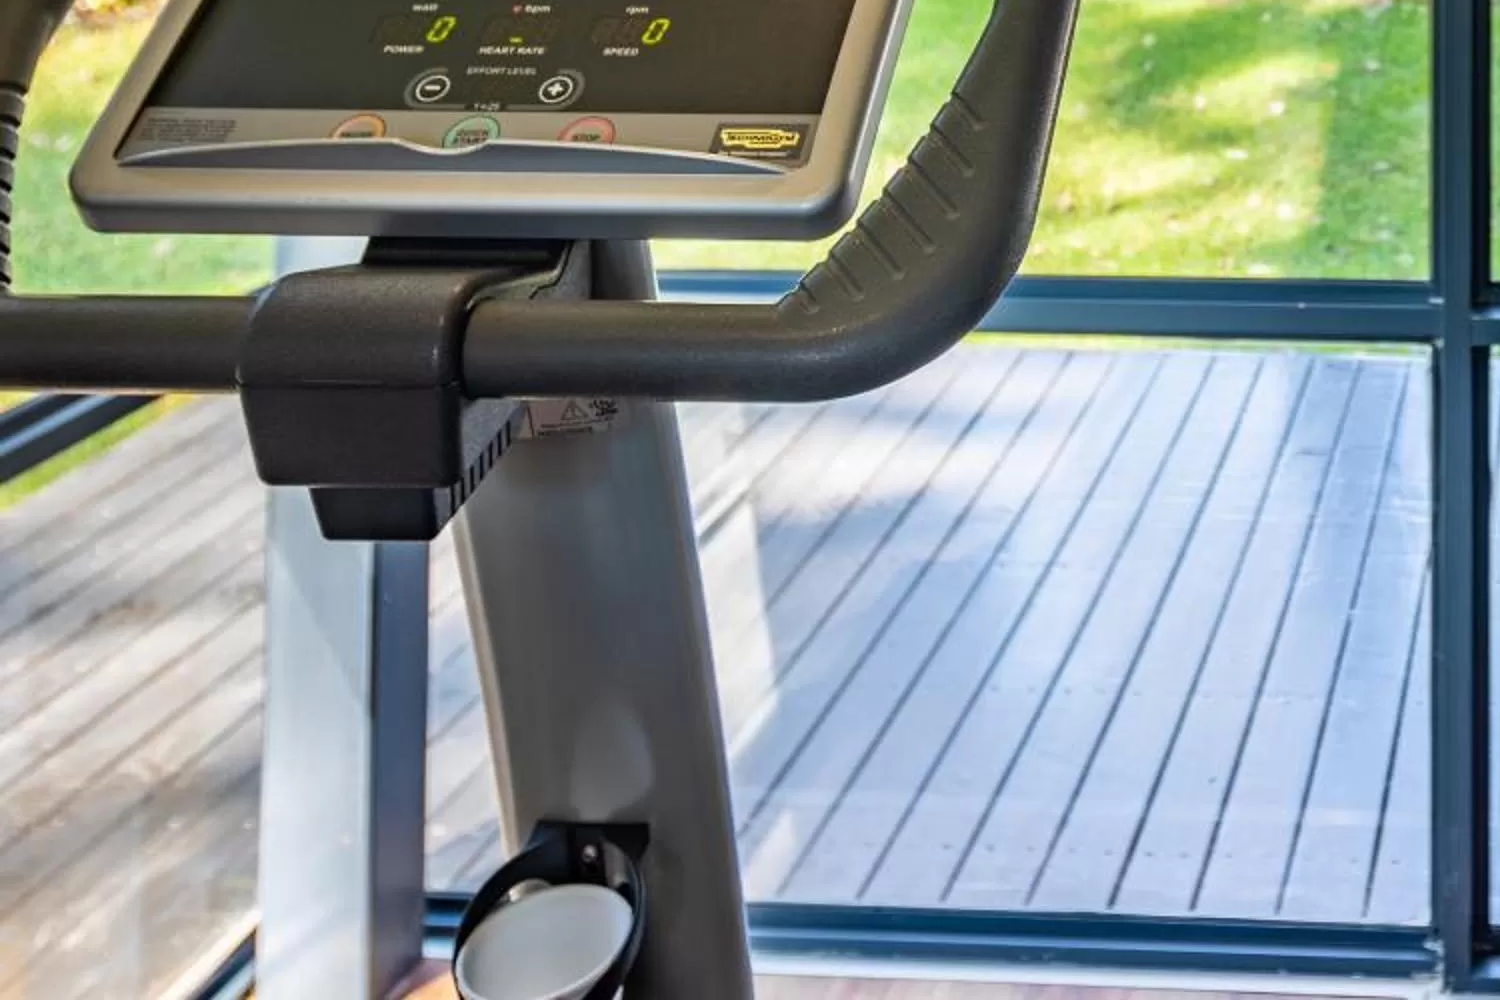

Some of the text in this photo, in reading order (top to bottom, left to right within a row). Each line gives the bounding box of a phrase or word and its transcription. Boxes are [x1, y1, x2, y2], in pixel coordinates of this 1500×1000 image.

[524, 4, 551, 14] bpm
[426, 16, 457, 43] 0
[641, 18, 672, 45] 0
[384, 45, 425, 54] POWER
[479, 46, 546, 56] HEART RATE
[603, 47, 640, 57] SPEED
